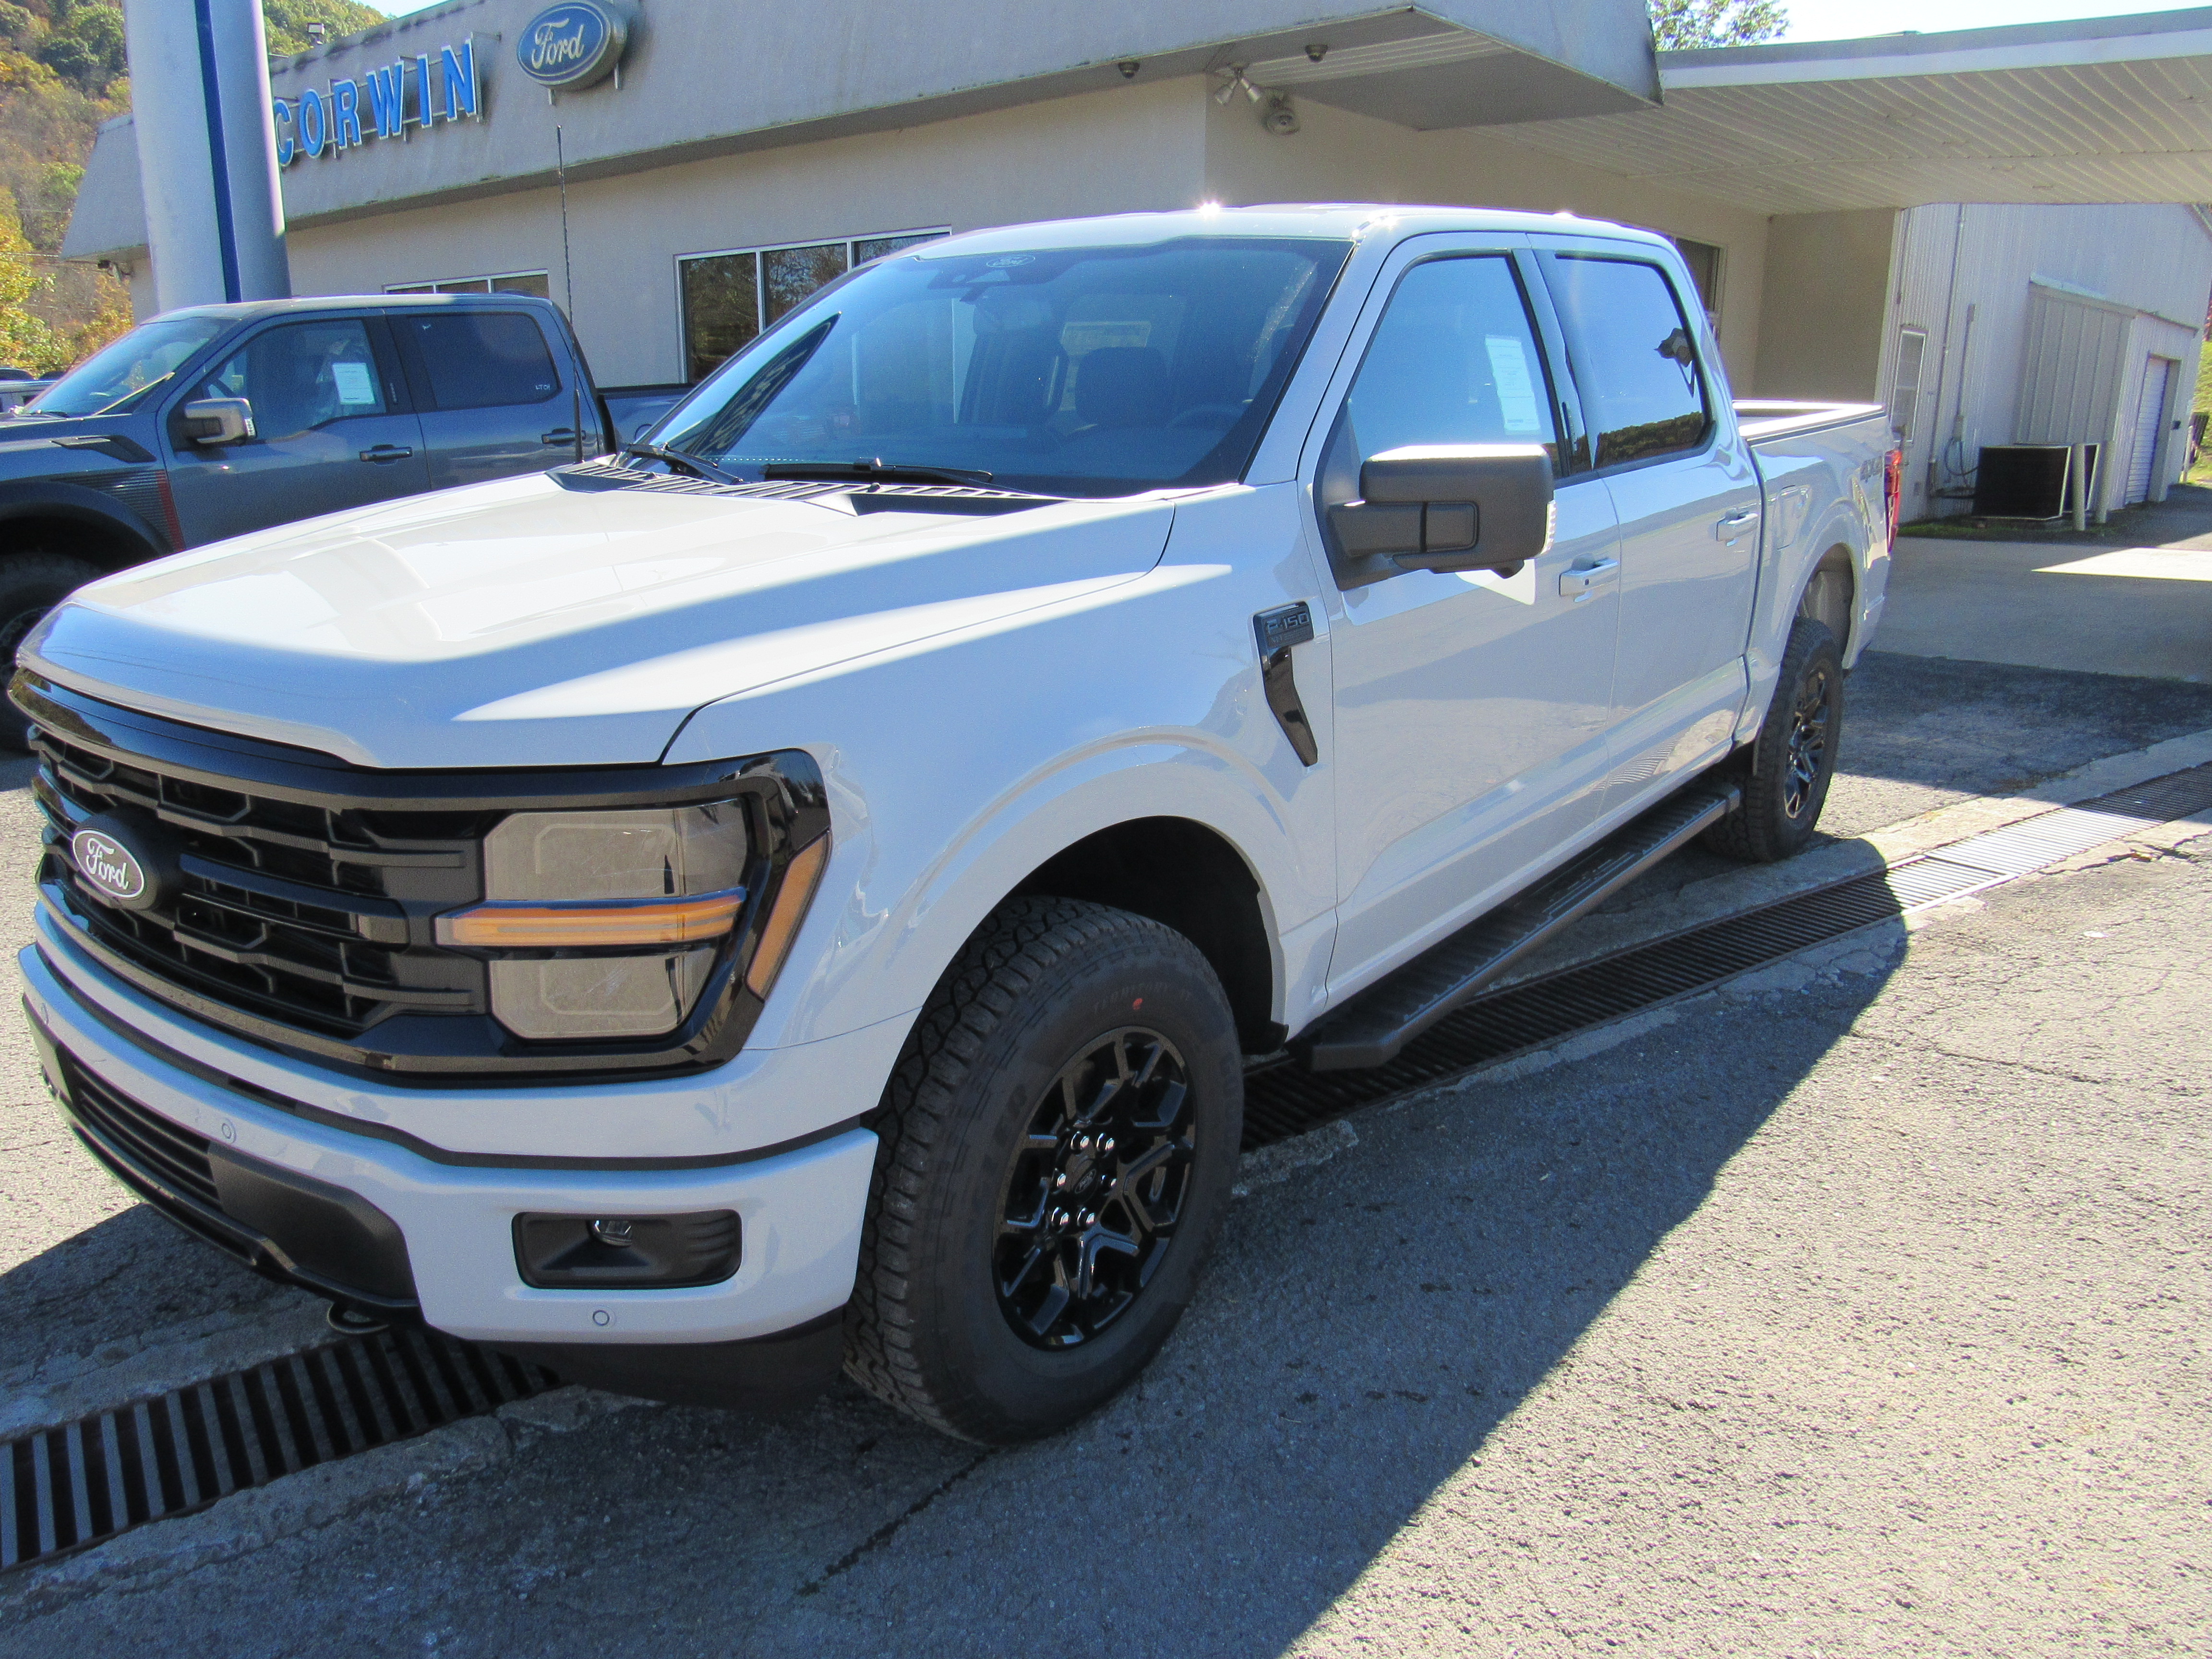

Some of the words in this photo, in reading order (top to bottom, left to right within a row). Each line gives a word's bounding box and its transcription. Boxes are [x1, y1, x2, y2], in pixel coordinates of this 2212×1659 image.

[531, 18, 585, 69] Ford
[274, 38, 478, 167] CORWIN
[1266, 612, 1310, 635] F-150
[86, 838, 129, 890] Ford
